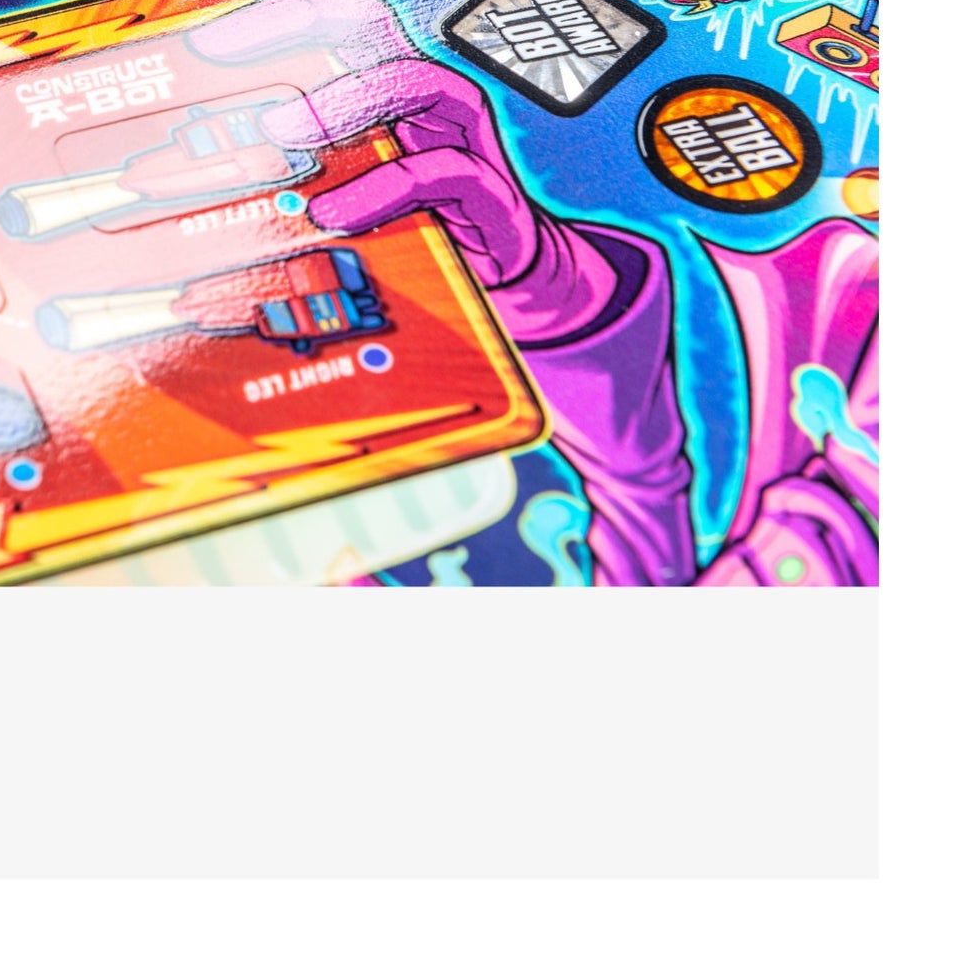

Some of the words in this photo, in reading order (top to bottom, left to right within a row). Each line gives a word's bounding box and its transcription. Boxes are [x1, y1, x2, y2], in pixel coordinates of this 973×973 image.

[485, 7, 571, 61] BOT
[15, 53, 170, 104] CONSTRUCT
[25, 73, 175, 129] A-BOT
[661, 117, 746, 185] EXTRA
[703, 104, 796, 172] BALL
[178, 211, 219, 237] LEG
[224, 198, 271, 225] LEFT
[242, 372, 287, 404] LEG
[289, 354, 356, 392] RIGHT
